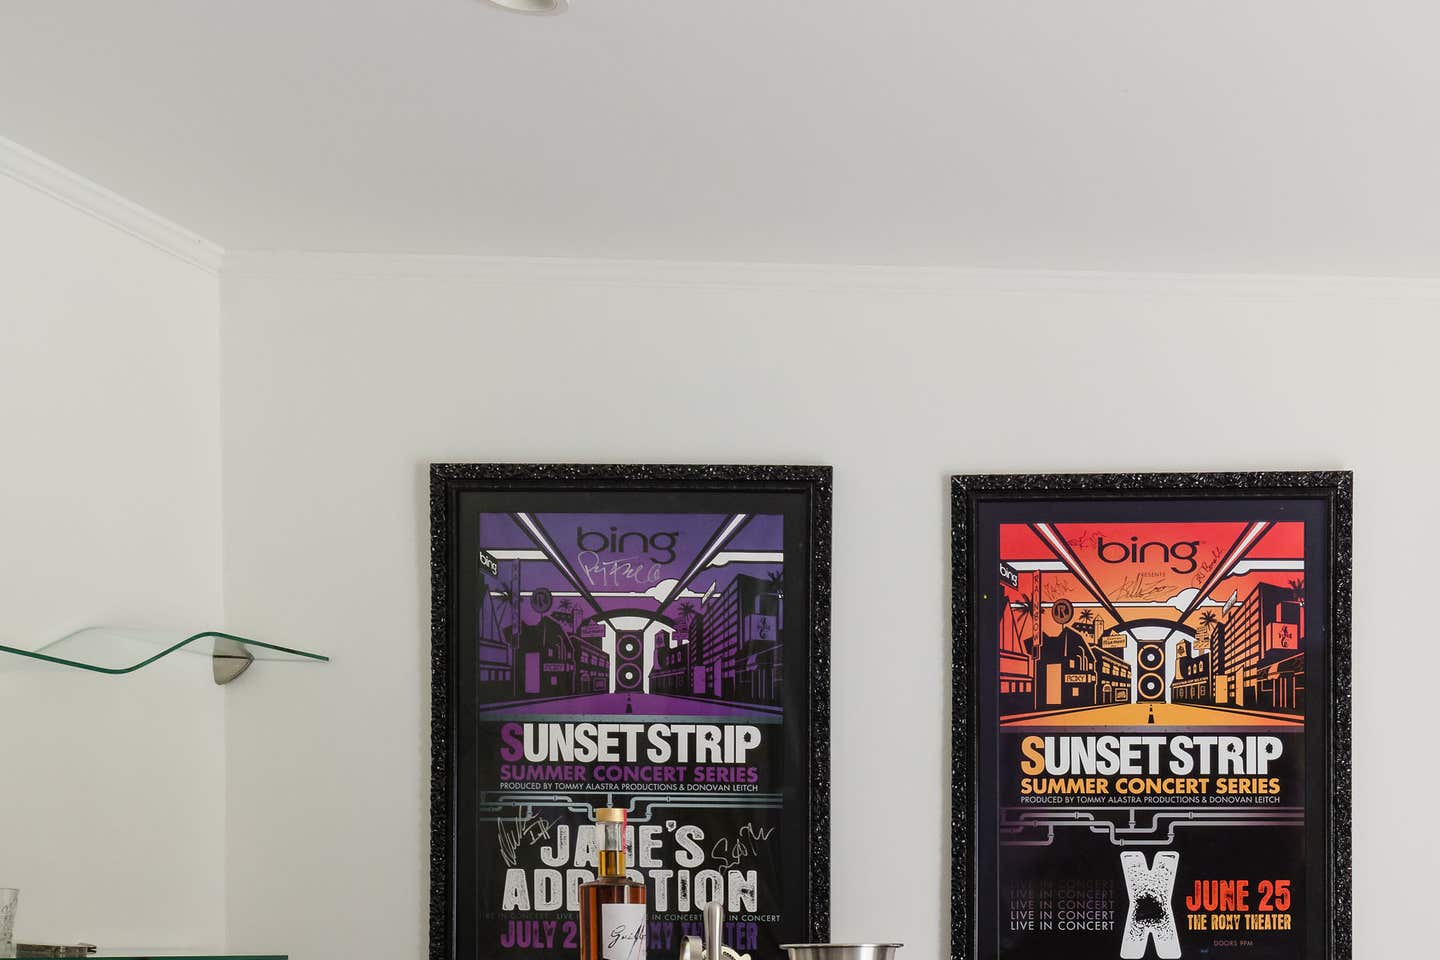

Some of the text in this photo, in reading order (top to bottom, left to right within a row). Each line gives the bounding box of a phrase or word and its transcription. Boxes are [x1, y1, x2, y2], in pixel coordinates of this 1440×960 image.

[577, 526, 680, 563] bing
[1097, 536, 1199, 574] bing
[480, 552, 497, 576] bing
[1000, 563, 1018, 587] bing
[501, 722, 762, 764] SUNSET STRIP
[1021, 735, 1283, 776] SUNSET STRIP
[500, 765, 758, 783] SUMMER CONCERT SERIES
[1020, 777, 1280, 795] SUMMER CONCERT SERIES
[500, 782, 758, 791] PRODUCED BY TOMMY ALASTRA PRODUCTIONS & DONOVAN LEITCH
[1020, 796, 1280, 804] PRODUCED BY TOMMY ALASTRA PRODUCTIONS & DONOVAN LEITCH
[502, 868, 758, 912] ADDTION
[1186, 879, 1291, 912] JUNE 25
[1010, 900, 1115, 910] LIVE IN CONCERT
[1010, 910, 1115, 920] LIVE IN CONCERT
[1120, 851, 1182, 960] X
[729, 914, 781, 922] IN CONCERT
[1010, 920, 1115, 931] LIVE IN CONCERT
[1187, 914, 1291, 931] THE ROXY THEATER
[500, 920, 557, 950] JULY
